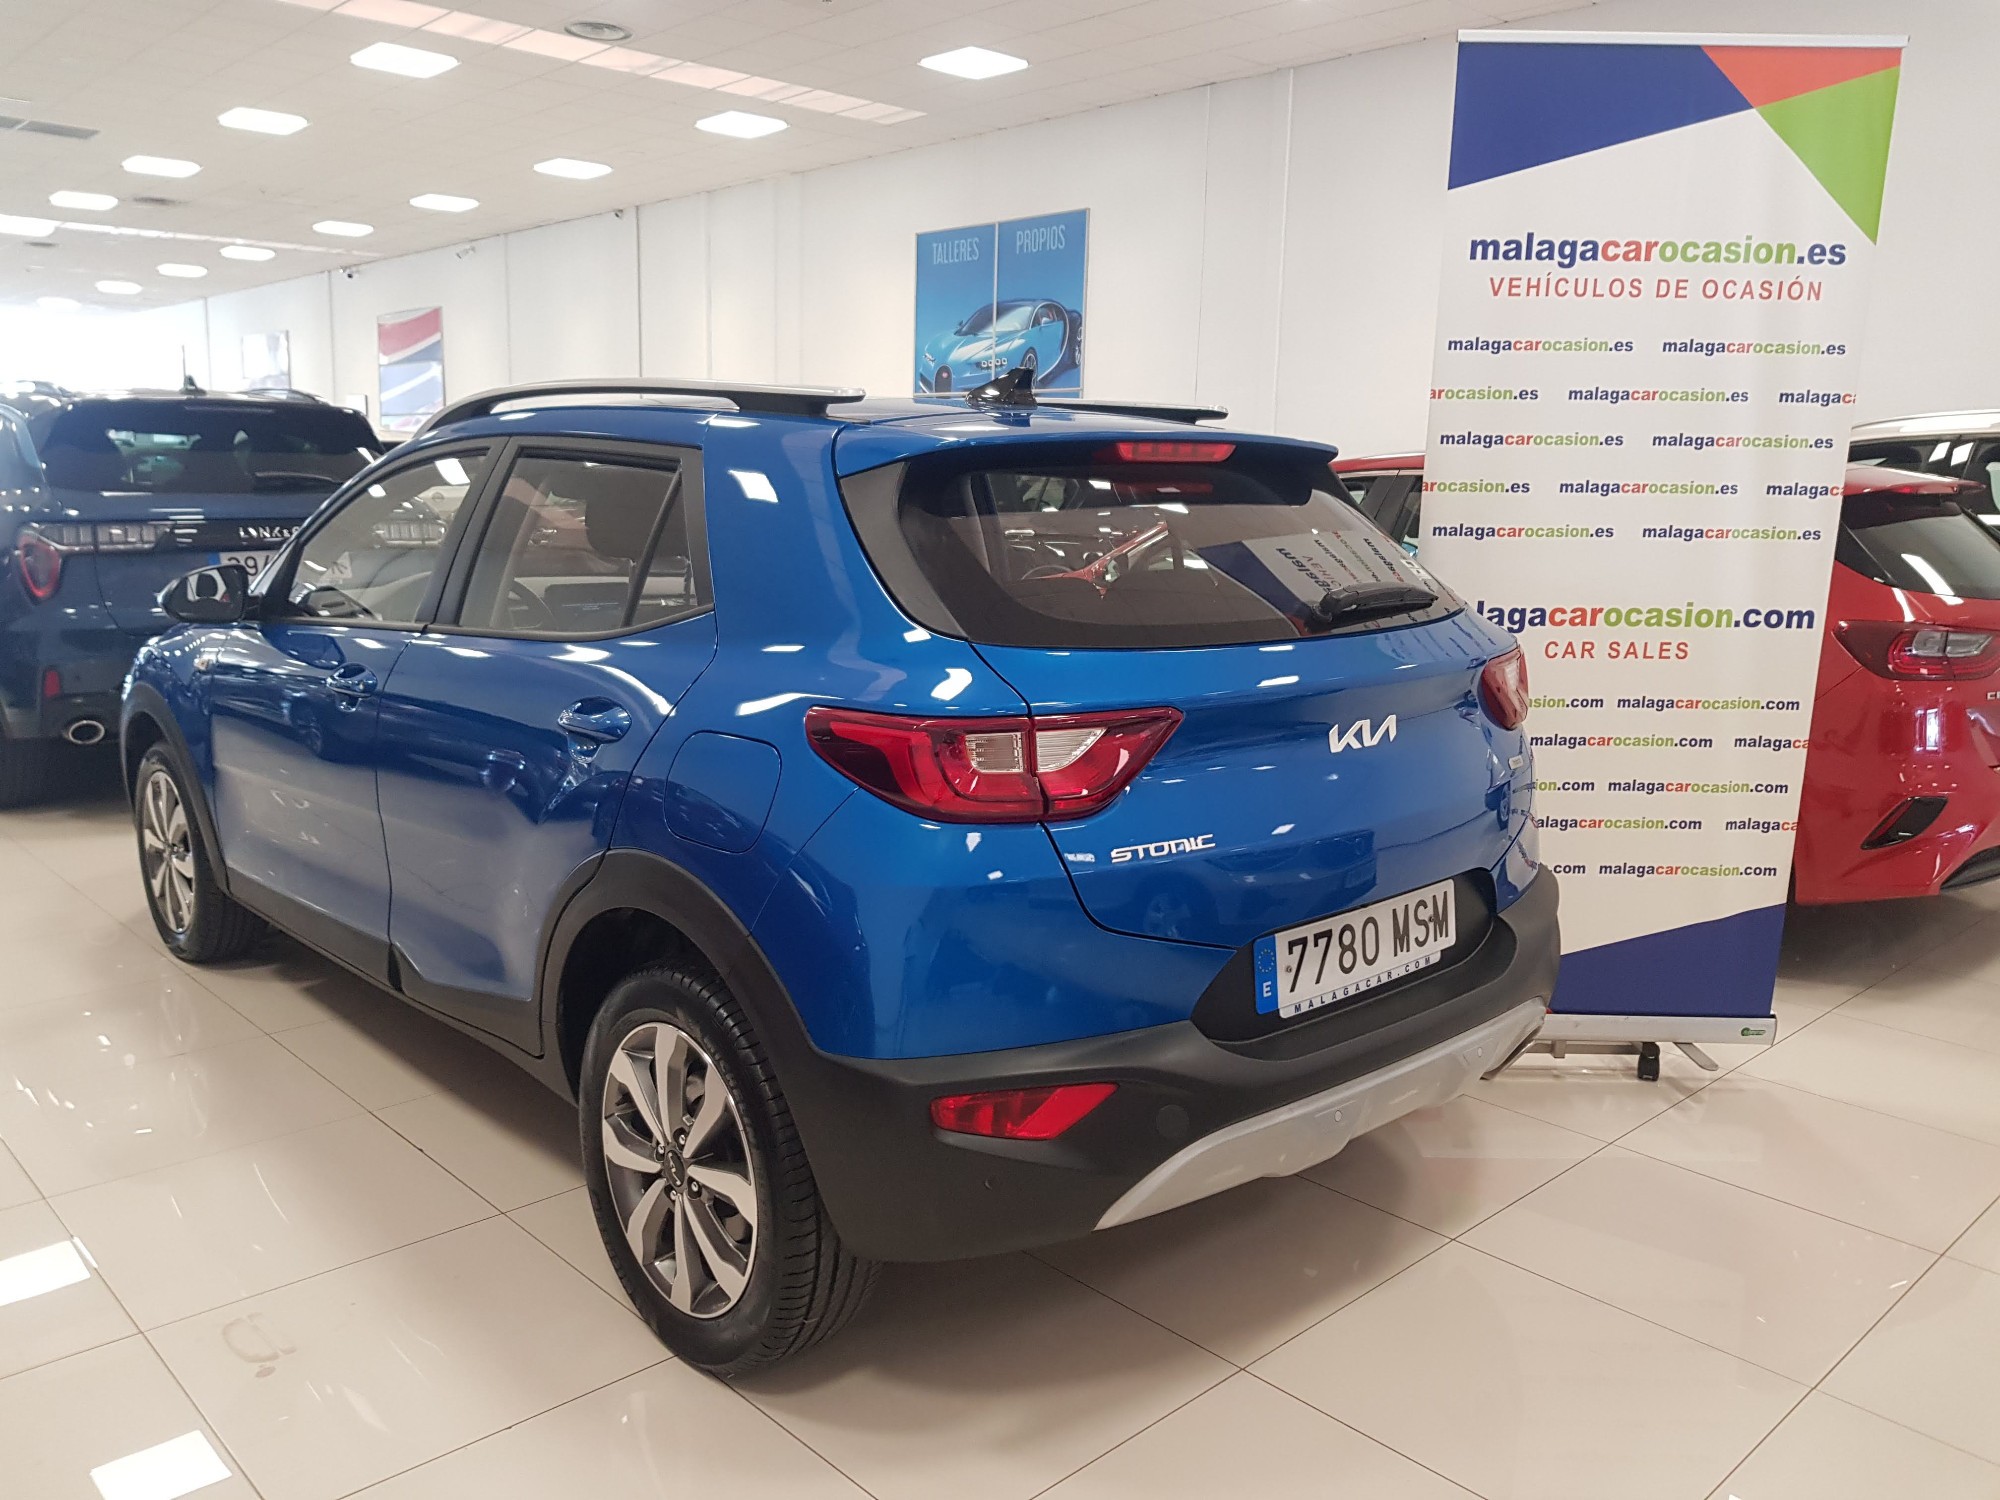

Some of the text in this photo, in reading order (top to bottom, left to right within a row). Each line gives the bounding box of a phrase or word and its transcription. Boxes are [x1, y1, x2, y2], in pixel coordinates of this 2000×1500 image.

[1016, 224, 1065, 254] PROPIOS
[933, 238, 980, 265] TALLERES
[1470, 232, 1846, 269] malagacarocasion.es
[1490, 272, 1821, 300] VEHÍCULOS DE OCASIÓN
[1448, 337, 1845, 356] malagacarocasion.es malagacarocasion.es
[1569, 387, 1748, 404] malagacarocasion.es
[1440, 431, 1833, 450] malagacarocasion.es malagacarocasion.es
[1560, 480, 1738, 497] malagacarocasion.es
[1433, 523, 1821, 542] malagacarocasion.es malagacarocasion.es
[1545, 641, 1688, 659] CAR SALES
[1617, 696, 1799, 712] malagacarocasion.com
[1328, 715, 1397, 753] KIA
[1530, 734, 1712, 749] malagacarocasion.com
[1608, 779, 1788, 795] malagacarocasion.com
[1110, 834, 1216, 863] STONIC
[1599, 863, 1777, 877] malagacarocasion.com
[1262, 890, 1449, 998] E 7780 MSM
[1294, 956, 1431, 1014] MALAGACAR.COM
